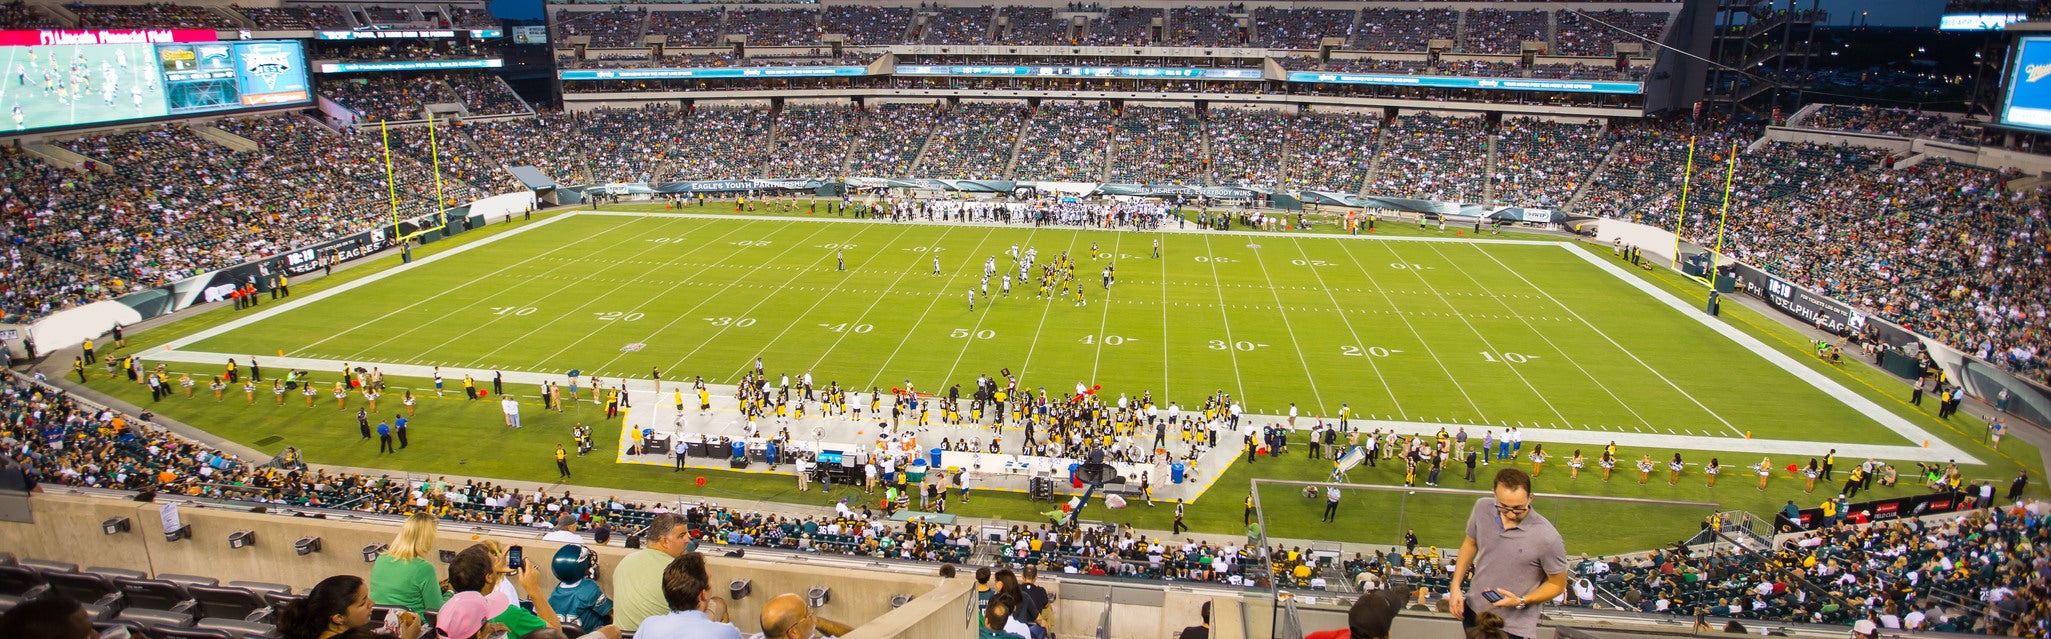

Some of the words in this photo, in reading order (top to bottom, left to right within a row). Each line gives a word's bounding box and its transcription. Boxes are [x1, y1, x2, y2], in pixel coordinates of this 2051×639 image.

[56, 30, 98, 45] Lincoln
[99, 30, 147, 44] Financial
[148, 29, 174, 43] Field
[692, 182, 723, 191] EAGLES
[725, 181, 751, 190] YOUTH
[754, 180, 808, 189] PARTNERSHIP
[1195, 188, 1233, 197] EVERYBODY
[494, 306, 538, 316] 10
[597, 311, 645, 322] 20
[711, 316, 757, 328] 30
[828, 322, 874, 334] 40
[950, 328, 996, 340] 50
[1078, 334, 1124, 346] 40
[1208, 339, 1255, 352] 30
[1341, 345, 1390, 358] 20
[1480, 350, 1528, 364] 10
